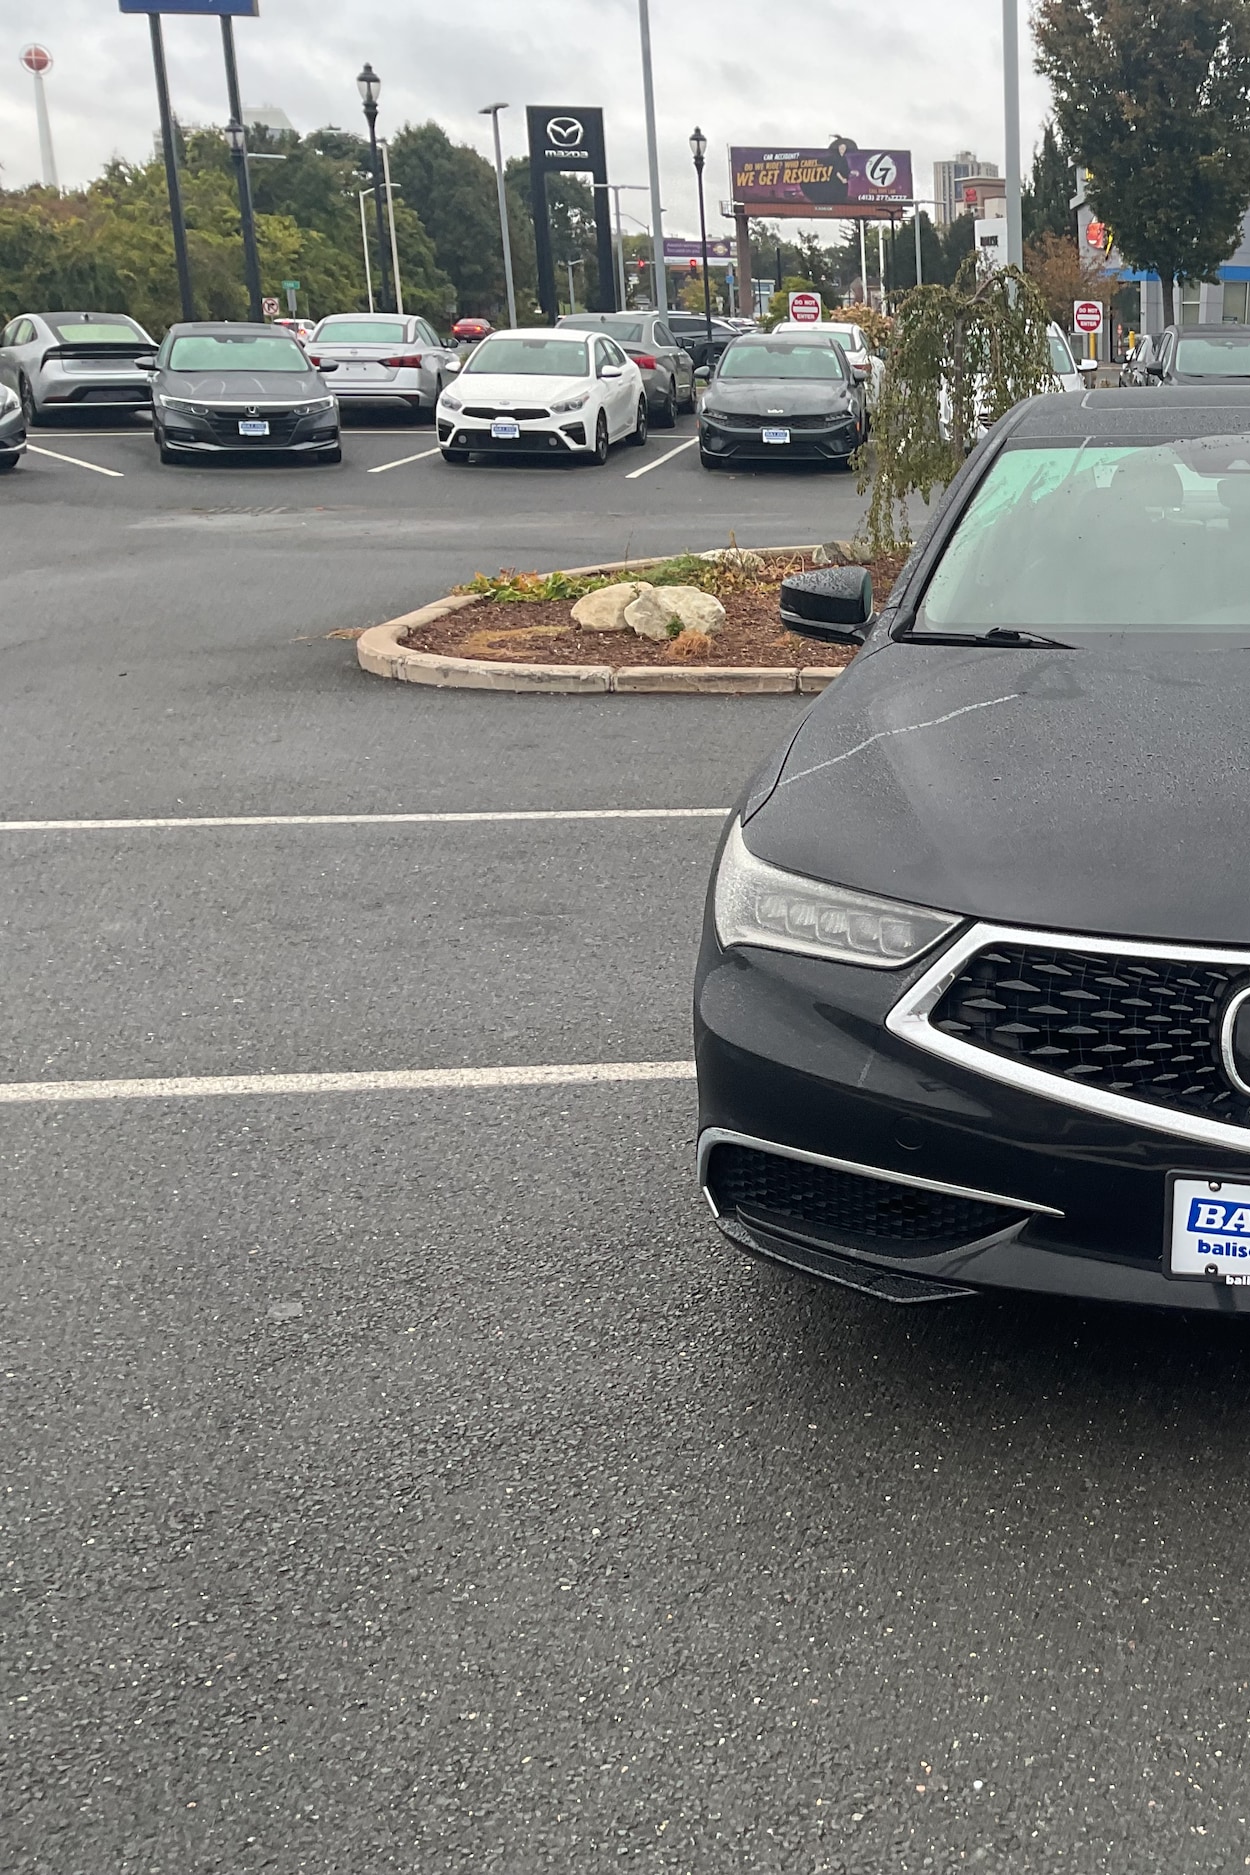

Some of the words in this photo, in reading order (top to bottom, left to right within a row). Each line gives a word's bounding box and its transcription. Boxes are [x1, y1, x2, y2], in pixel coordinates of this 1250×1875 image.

[763, 153, 774, 161] CAR
[736, 171, 755, 187] WE
[758, 170, 780, 186] GET
[783, 165, 834, 184] RESULTS!
